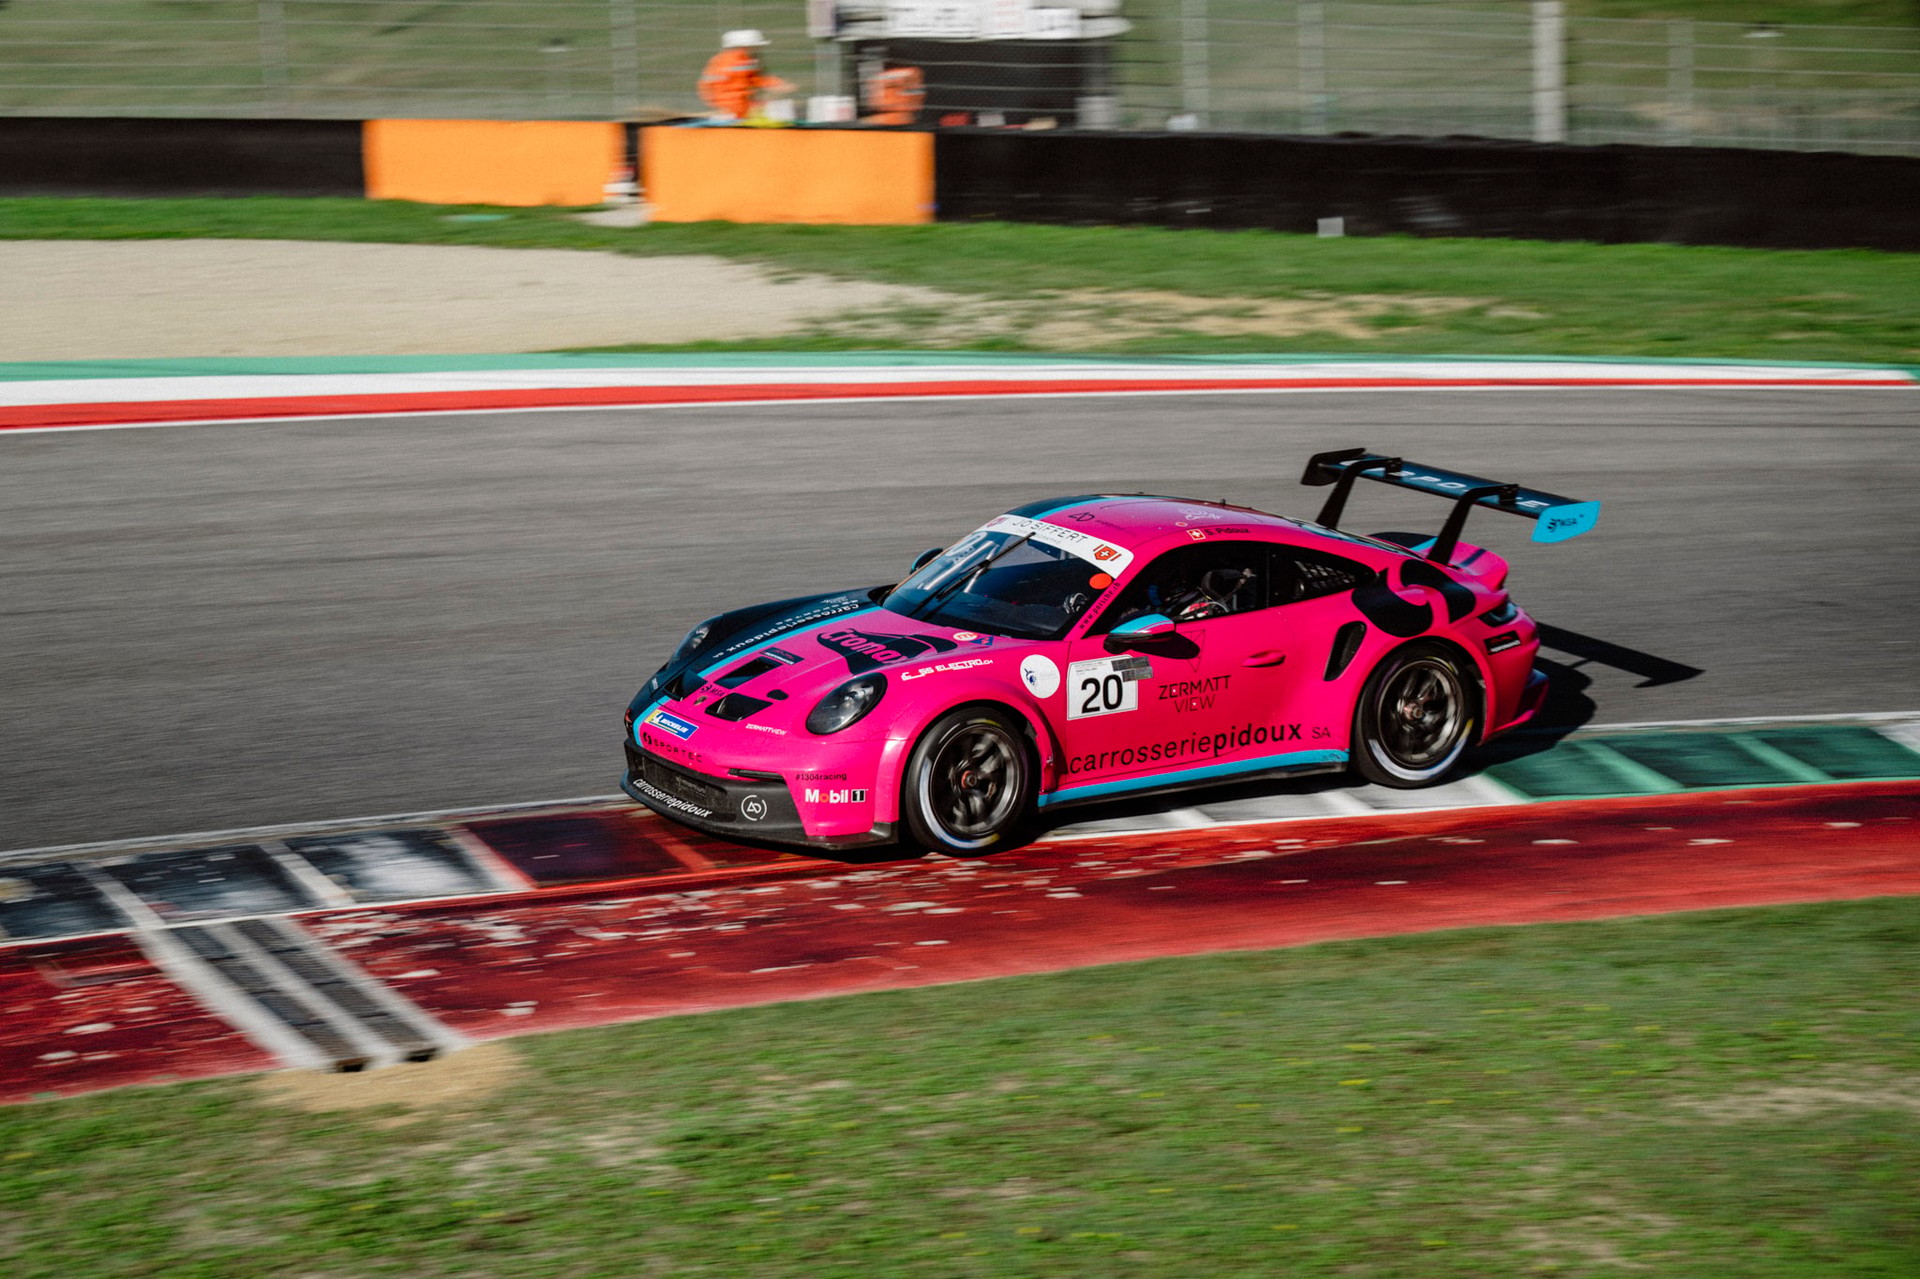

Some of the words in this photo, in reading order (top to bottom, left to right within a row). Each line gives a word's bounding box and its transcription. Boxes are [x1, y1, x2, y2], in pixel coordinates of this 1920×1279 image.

[1081, 674, 1123, 714] 20
[1158, 675, 1232, 700] ZERMATT
[1174, 694, 1216, 713] VIEW
[653, 738, 703, 763] SPORTEC
[1069, 722, 1302, 775] carrosseriepidoux
[1311, 726, 1332, 740] SA
[795, 772, 848, 782] #1304racing
[632, 777, 712, 819] carrosseriepidoux
[804, 788, 849, 804] Mobil
